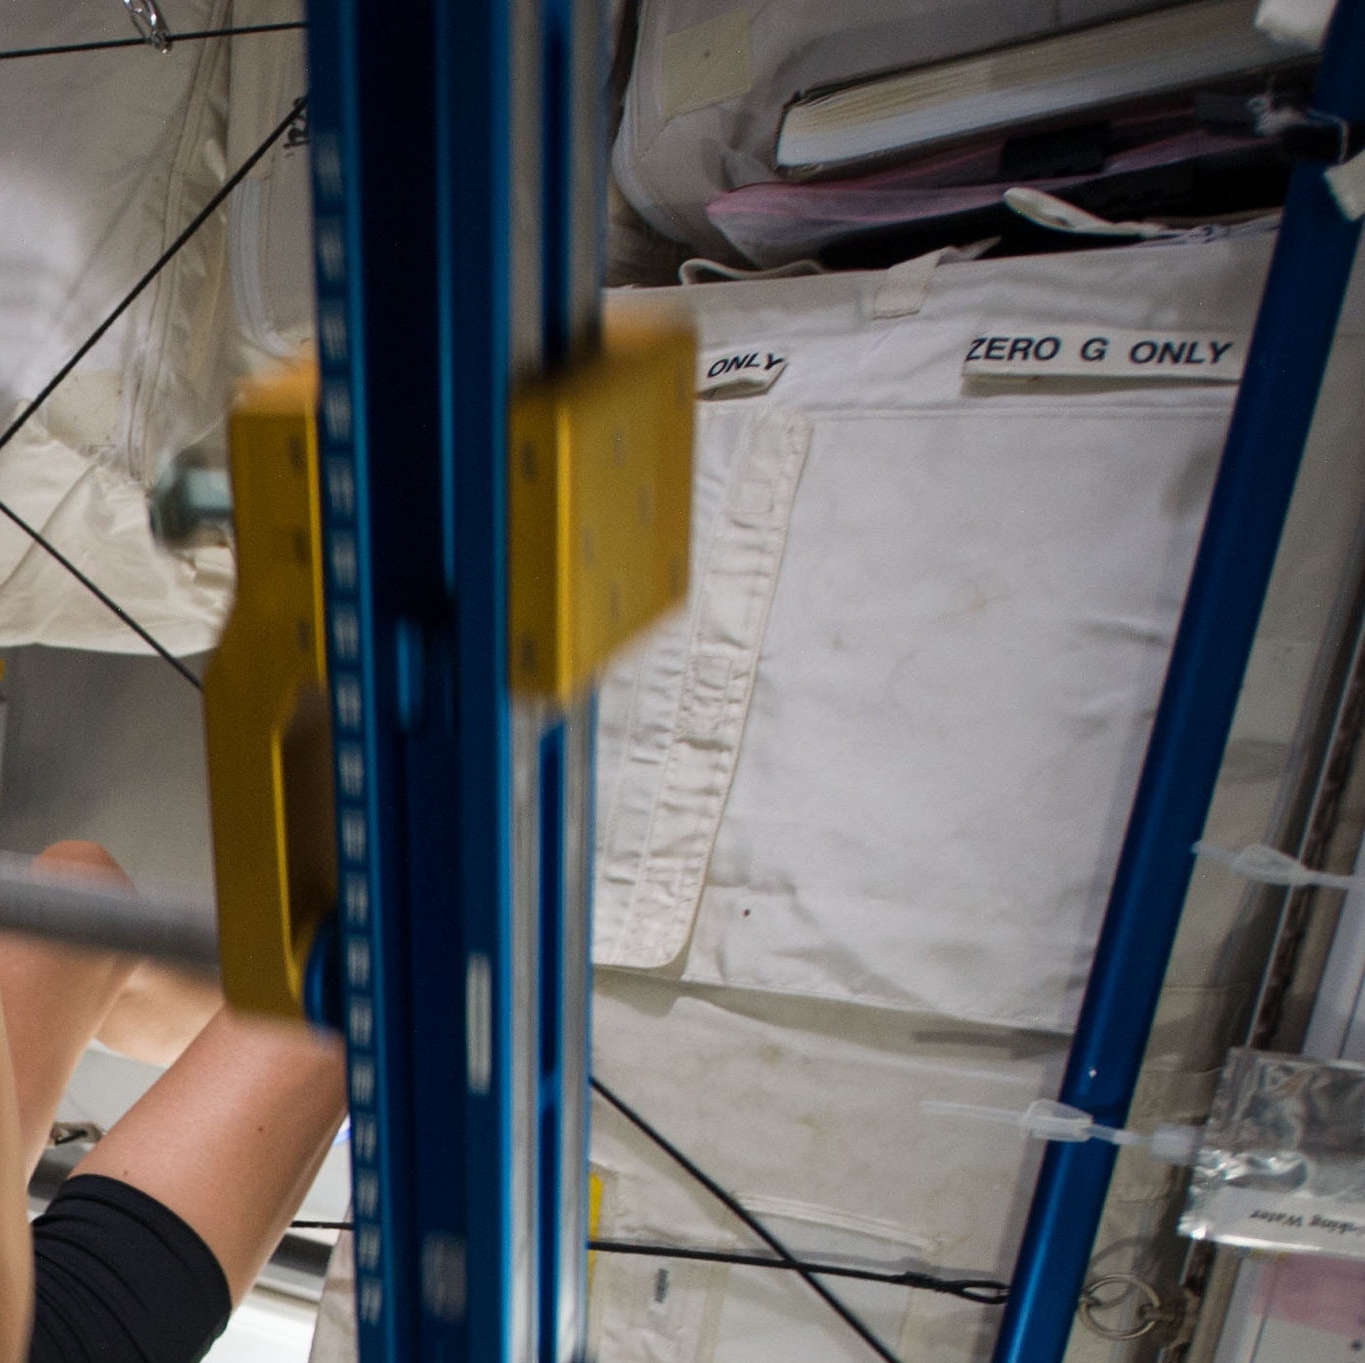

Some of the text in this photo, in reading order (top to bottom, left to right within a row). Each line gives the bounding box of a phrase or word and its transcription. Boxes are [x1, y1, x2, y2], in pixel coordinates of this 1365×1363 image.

[966, 336, 1233, 365] ZERO G ONLY
[707, 352, 784, 378] ONLY
[1249, 1209, 1304, 1228] Water
